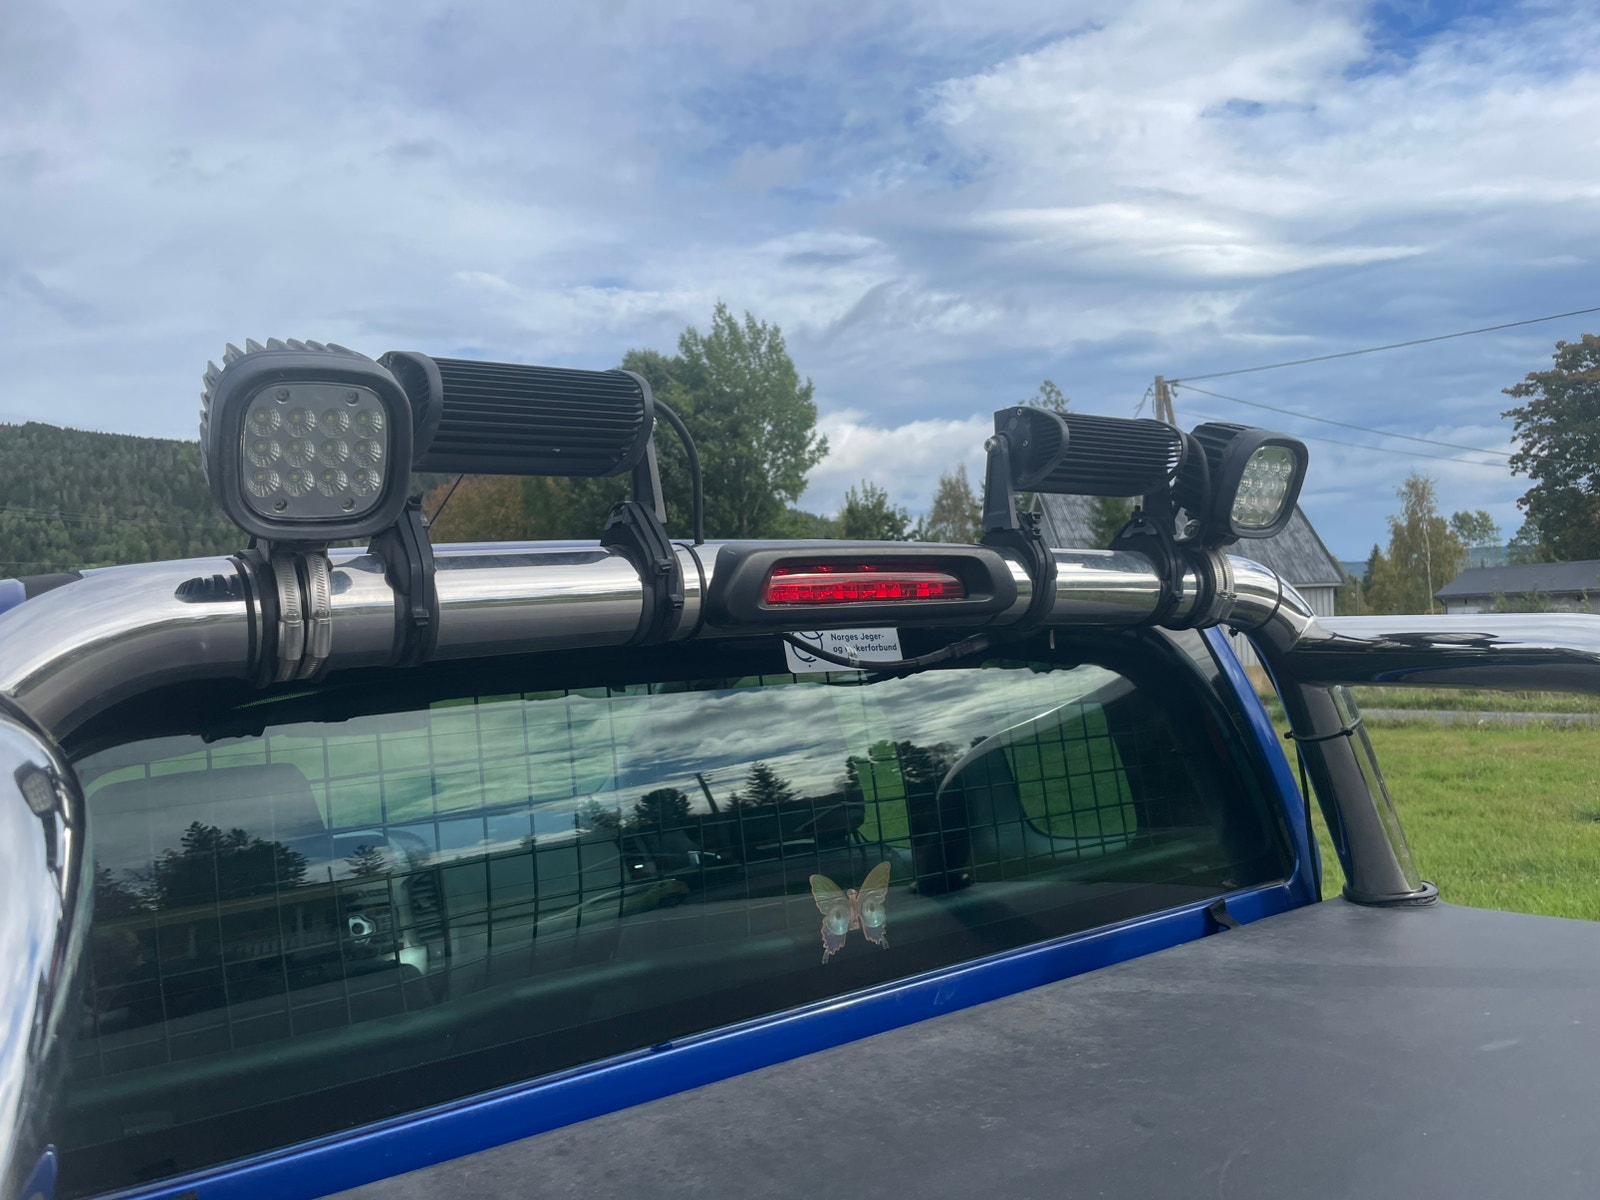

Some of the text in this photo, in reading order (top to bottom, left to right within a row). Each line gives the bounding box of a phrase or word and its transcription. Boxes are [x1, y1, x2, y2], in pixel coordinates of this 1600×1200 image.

[831, 633, 858, 642] Norges
[833, 643, 897, 654] og kerforbund
